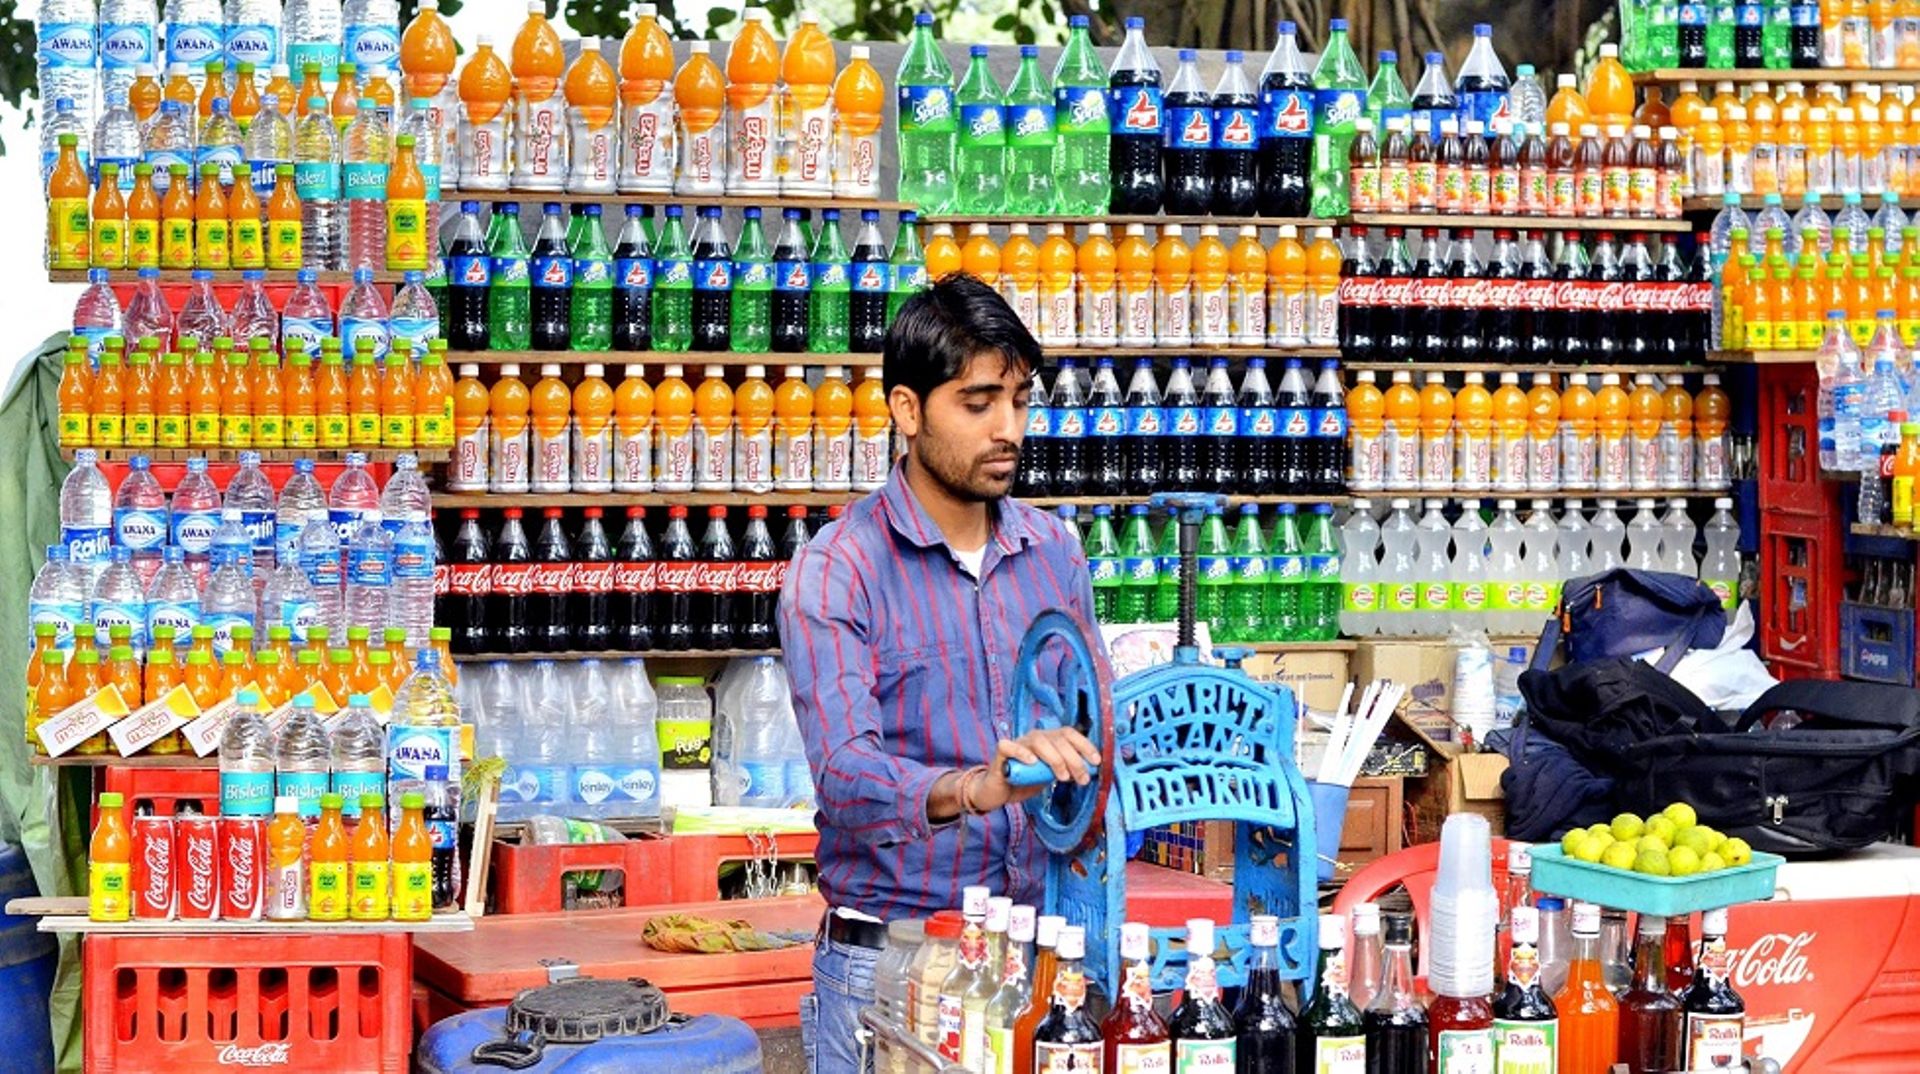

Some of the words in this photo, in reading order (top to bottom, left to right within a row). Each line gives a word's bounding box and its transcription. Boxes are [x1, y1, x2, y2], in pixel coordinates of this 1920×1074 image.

[52, 38, 92, 50] AWANA
[105, 38, 144, 50] AWANA
[175, 38, 214, 50] AWANA
[229, 40, 269, 51] AWANA
[356, 40, 396, 52] AWANA
[533, 109, 552, 176] maaza
[635, 113, 656, 177] maaza
[743, 116, 765, 180] maaza
[803, 117, 823, 181] maaza
[348, 170, 385, 187] Bisleri
[123, 525, 156, 535] AWANA
[246, 513, 274, 539] ain
[70, 531, 111, 562] Rain
[396, 746, 441, 762] AWANA
[225, 782, 269, 800] Bisleri
[285, 782, 326, 799] Bisleri
[338, 781, 381, 798] Bisleri
[580, 780, 611, 794] kinley
[621, 777, 655, 791] kinley
[144, 834, 169, 909] Coca-Cola
[187, 834, 213, 910] Coca-Cola
[229, 834, 254, 909] Coca-Cola
[216, 1043, 292, 1066] Coca-Cola
